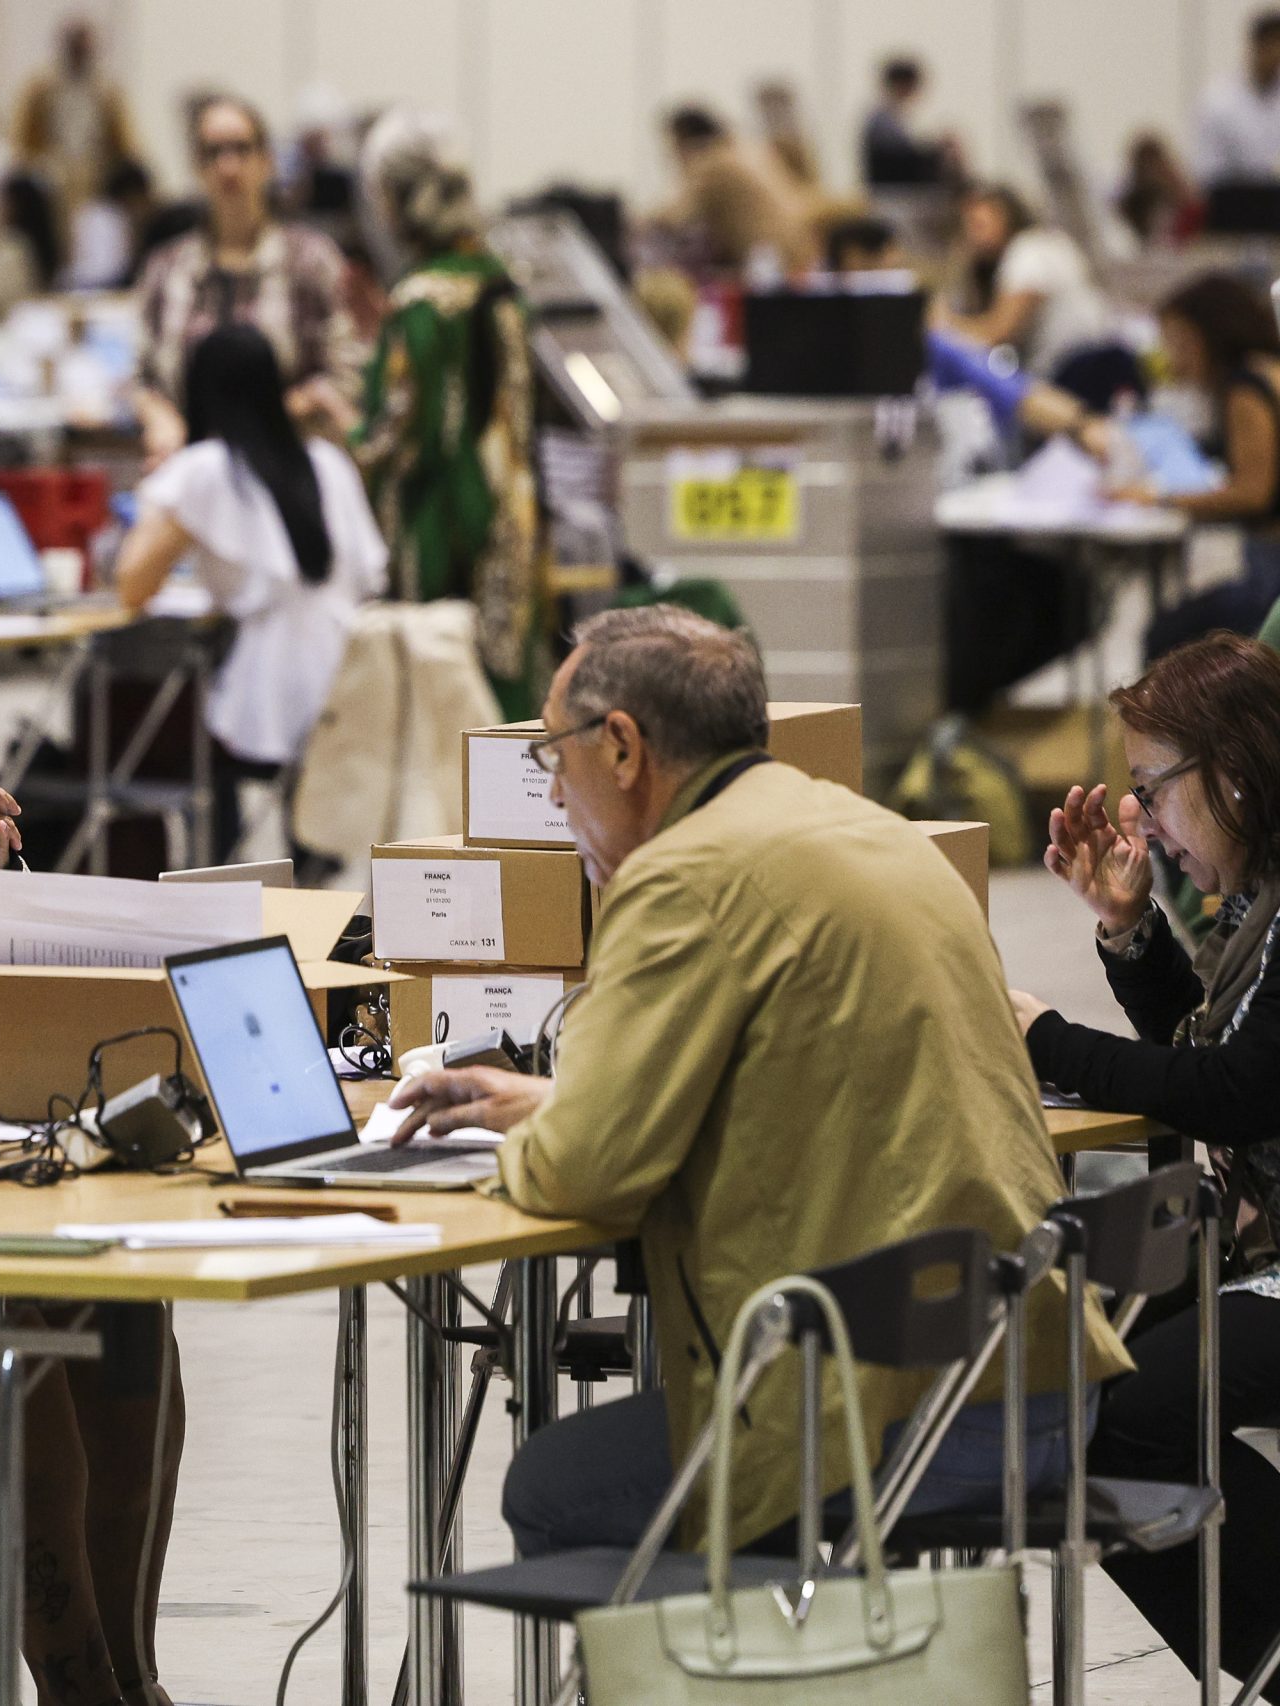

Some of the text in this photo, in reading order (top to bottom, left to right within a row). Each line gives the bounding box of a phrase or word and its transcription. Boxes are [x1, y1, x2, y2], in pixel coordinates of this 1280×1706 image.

[424, 873, 451, 881] FRANÇA
[481, 938, 496, 946] 131
[485, 987, 512, 995] FRANÇA
